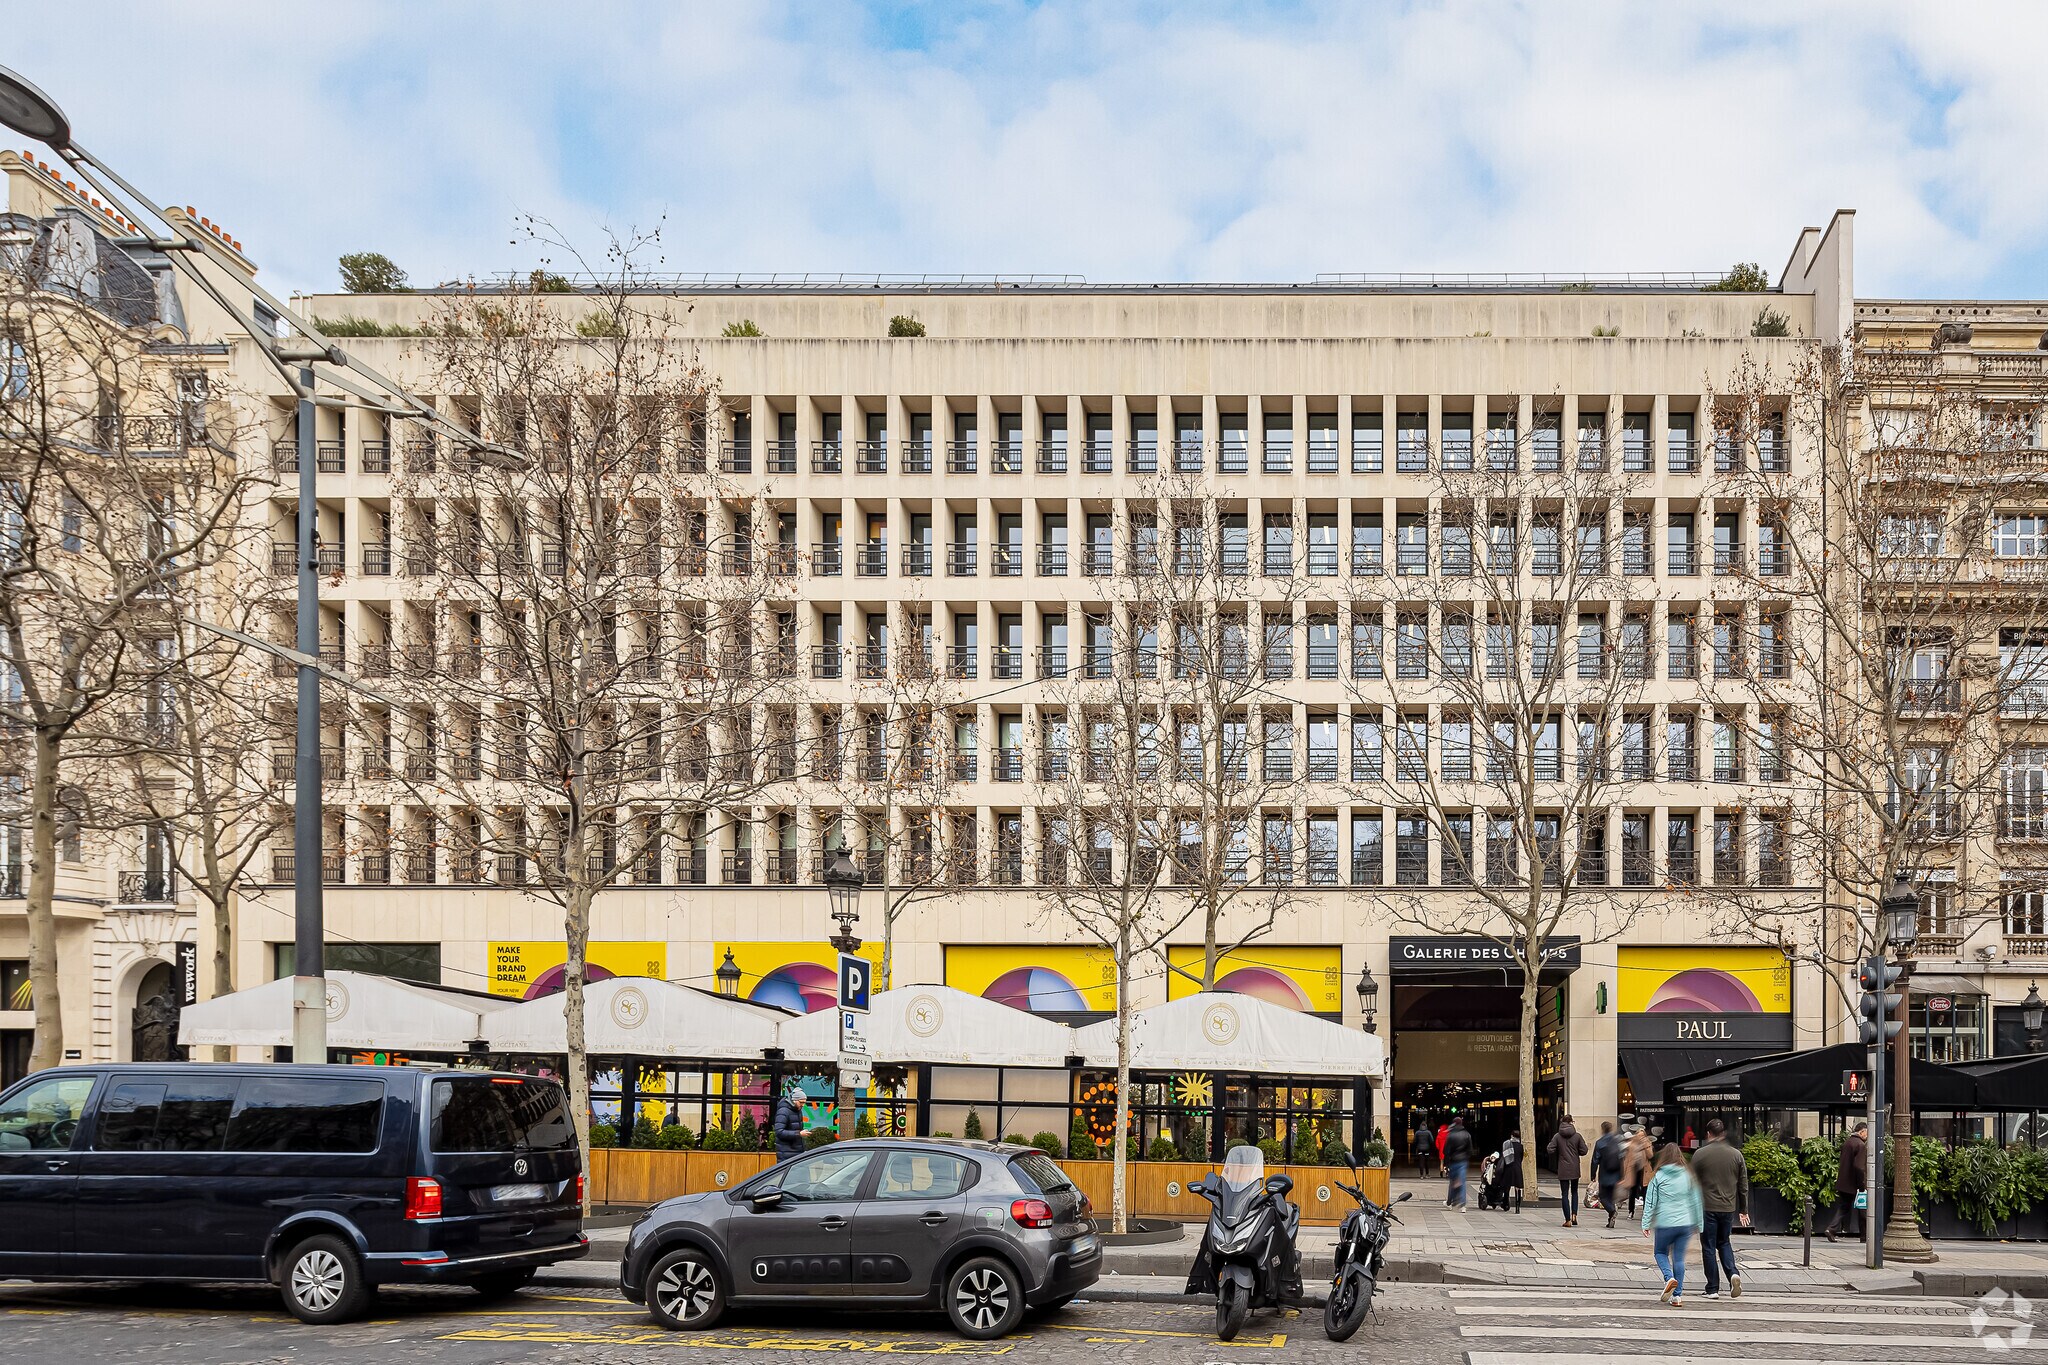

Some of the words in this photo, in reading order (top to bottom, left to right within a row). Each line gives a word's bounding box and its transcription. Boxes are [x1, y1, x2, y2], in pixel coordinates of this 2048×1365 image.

[497, 946, 521, 954] MAKE
[1472, 948, 1500, 959] DES
[1503, 945, 1567, 959] CHMPS
[497, 955, 520, 963] YOUR
[180, 947, 195, 1002] wework
[497, 974, 527, 982] DREAM
[848, 966, 863, 1000] P
[1102, 992, 1115, 1000] SFL
[1325, 992, 1338, 1001] SFL
[620, 999, 638, 1017] 86
[846, 1015, 853, 1027] P
[915, 1007, 933, 1025] 86
[1212, 1015, 1230, 1033] 86
[1676, 1020, 1733, 1039] PAUL
[1476, 1034, 1513, 1042] BOUTIQUES
[1473, 1044, 1520, 1052] RESTAURANT
